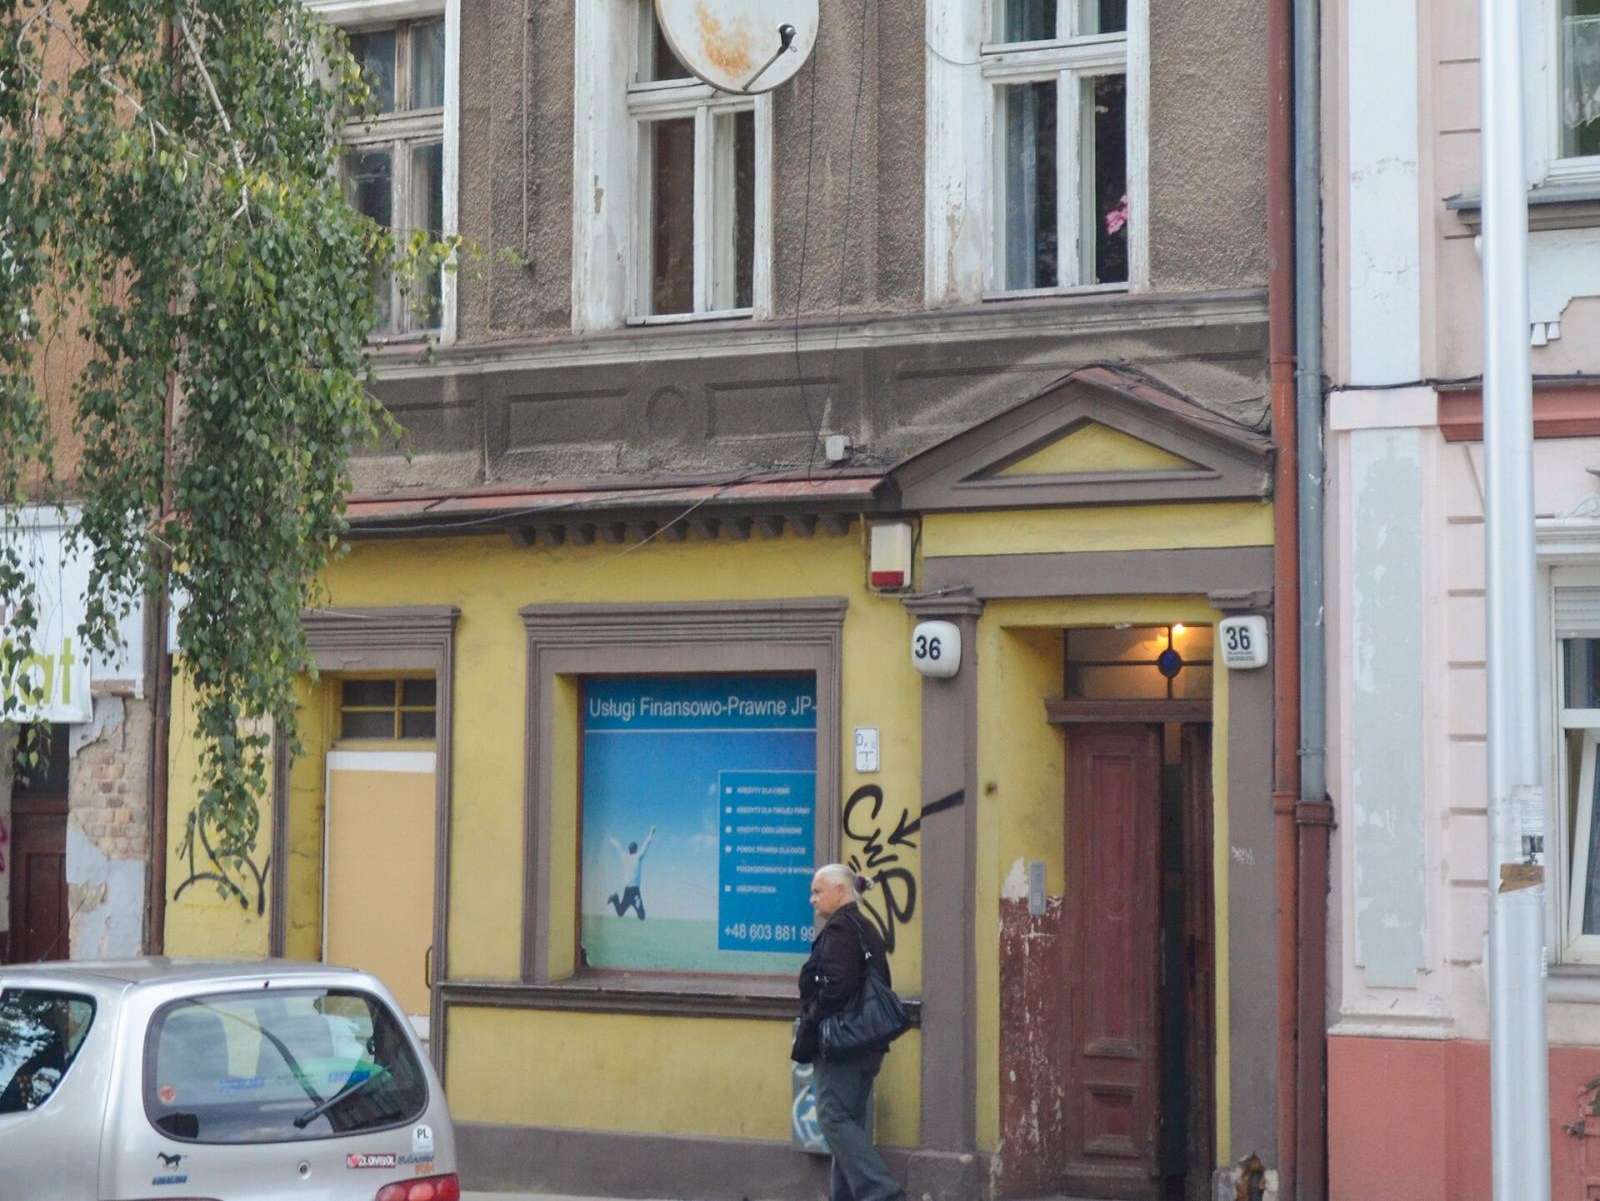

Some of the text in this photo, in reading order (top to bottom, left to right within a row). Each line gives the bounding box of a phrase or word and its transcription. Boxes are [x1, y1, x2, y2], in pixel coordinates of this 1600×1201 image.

[914, 634, 941, 661] 36
[1226, 626, 1251, 651] 36
[589, 698, 636, 721] Usługi
[640, 696, 787, 717] Finansowo-Prawne
[736, 786, 761, 795] KREDYTY
[736, 806, 761, 815] KREDYTY
[725, 923, 747, 939] +48
[749, 924, 772, 940] 603
[775, 925, 796, 941] 881
[417, 1128, 429, 1139] PL
